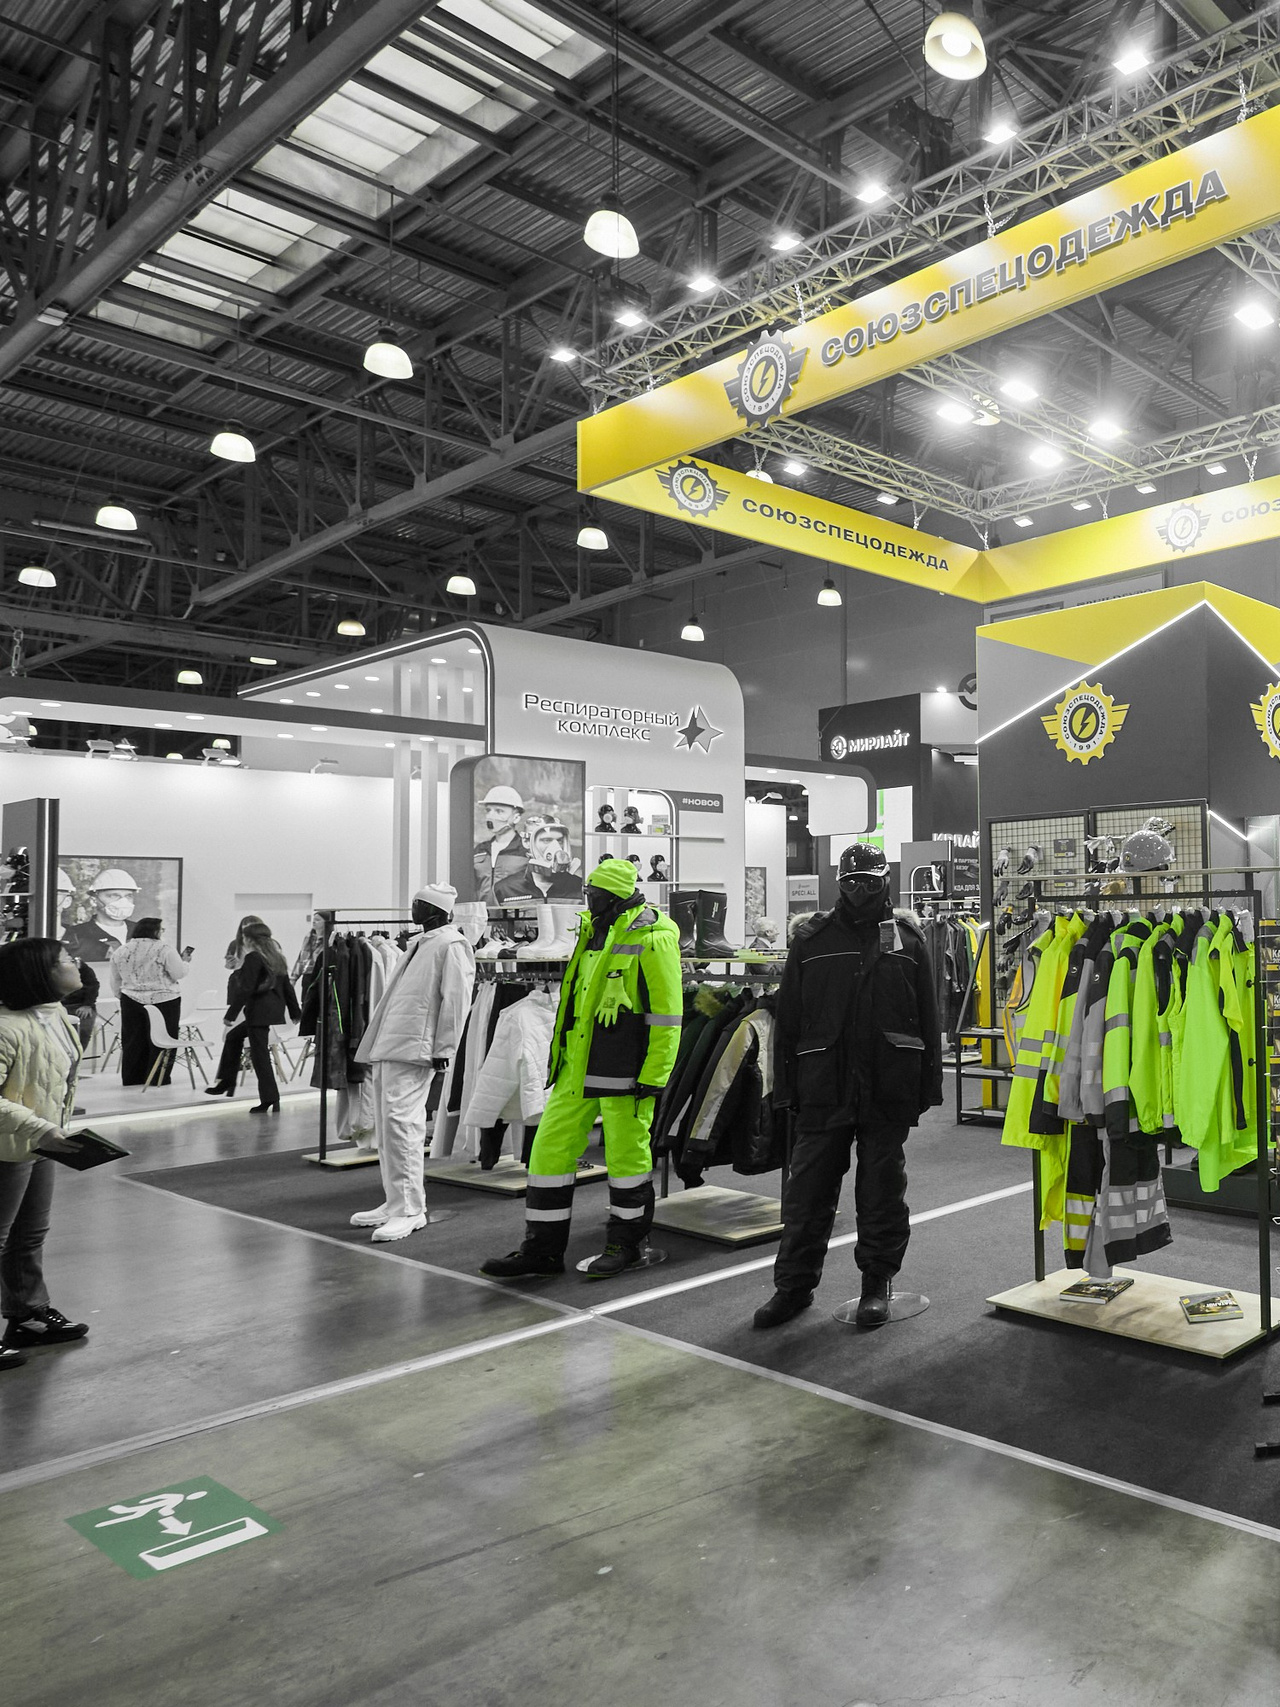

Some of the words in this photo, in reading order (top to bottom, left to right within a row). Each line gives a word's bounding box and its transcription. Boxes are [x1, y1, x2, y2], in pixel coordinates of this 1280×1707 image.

[821, 169, 1227, 367] СОЮЗСПЕЦОДЕЖДА
[743, 346, 785, 402] СОЮЗСПЕЦОДЕЖДА
[742, 498, 949, 571] СОЮЗСПЕЦОДЕЖДА
[524, 693, 681, 727] Респираторный
[557, 719, 651, 741] комплекс
[1062, 694, 1107, 740] СОЮЗСПЕЦОДЕЖДА
[848, 729, 910, 753] МИРЛАЙТ
[1073, 740, 1098, 751] 1991
